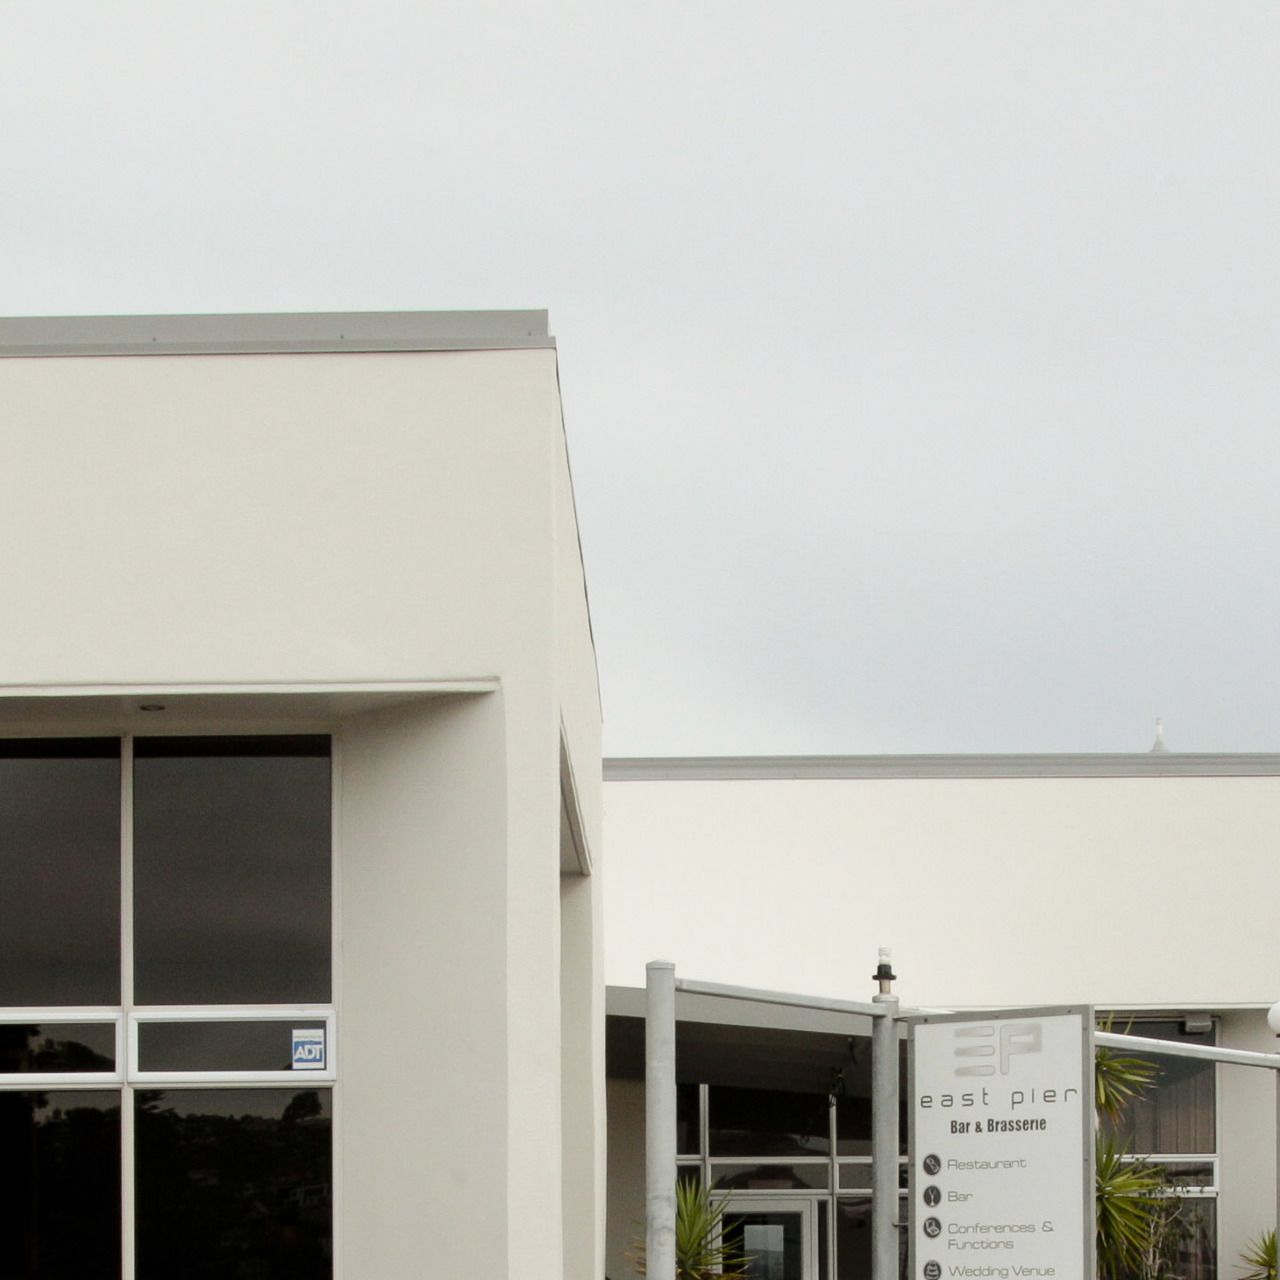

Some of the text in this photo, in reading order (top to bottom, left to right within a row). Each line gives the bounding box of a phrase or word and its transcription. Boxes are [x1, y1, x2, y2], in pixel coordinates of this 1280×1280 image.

[294, 1044, 323, 1060] ADT
[920, 1088, 1077, 1110] east pier
[950, 1118, 1047, 1134] Bar & Brasserie
[947, 1159, 1027, 1170] Restaurant
[948, 1191, 973, 1202] Bar
[948, 1221, 1054, 1234] Conferences &
[948, 1239, 1014, 1250] Functions
[948, 1265, 1055, 1279] Wedding Venue
